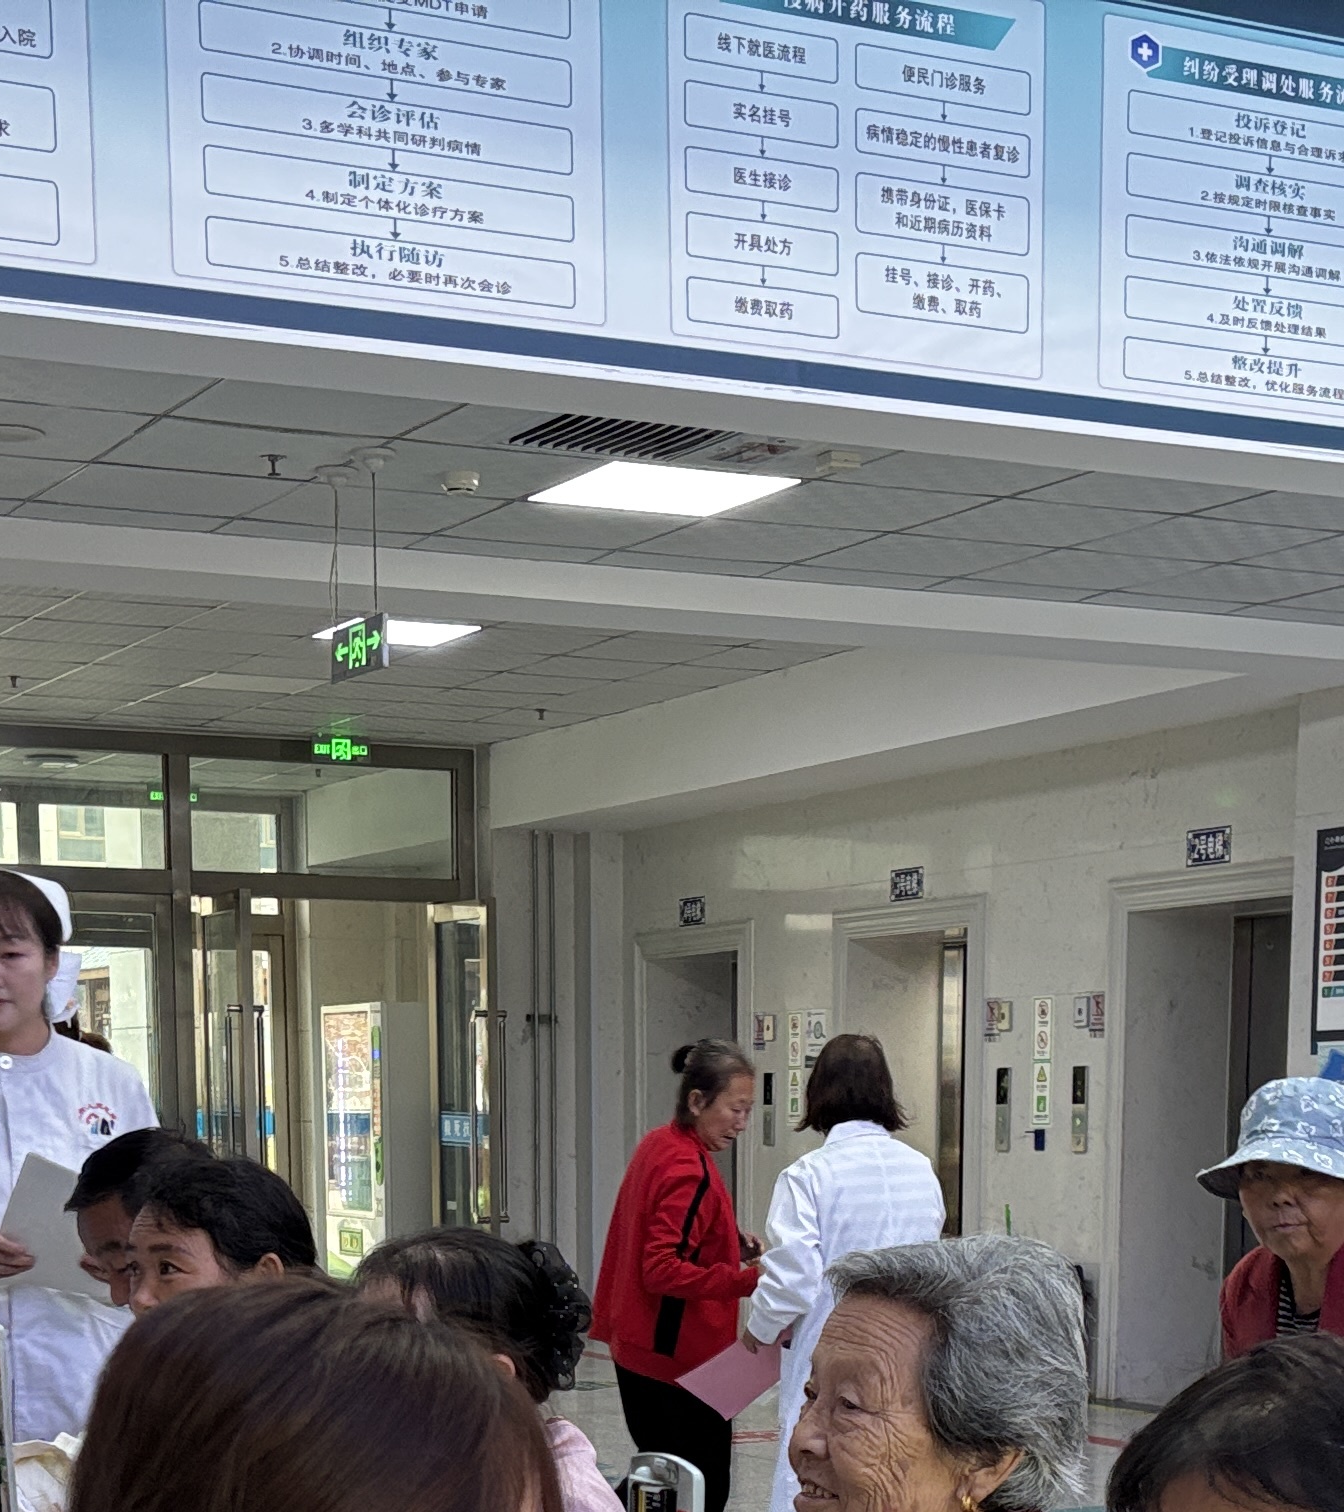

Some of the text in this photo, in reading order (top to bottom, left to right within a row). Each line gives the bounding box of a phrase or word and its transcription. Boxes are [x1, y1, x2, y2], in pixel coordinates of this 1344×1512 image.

[342, 29, 439, 61] 组织专家
[717, 32, 807, 65] 线下就医流程
[902, 64, 987, 95] 便民门诊服务
[345, 100, 440, 131] 会诊评估
[733, 102, 792, 127] 实名挂号
[1234, 112, 1308, 140] 投诉登记
[348, 169, 443, 200] 制定方案
[733, 167, 792, 192] 医生接诊
[1234, 174, 1307, 200] 调查核实
[305, 189, 485, 225] 4.制定个体化诊疗方案
[894, 212, 993, 242] 和近期病历资料
[350, 239, 446, 269] 执行随访
[733, 232, 794, 257] 开具处方
[1233, 236, 1305, 260] 沟通调解
[734, 296, 794, 321] 缴费取药
[1233, 295, 1304, 320] 处置反馈
[1232, 355, 1303, 379] 整改提升
